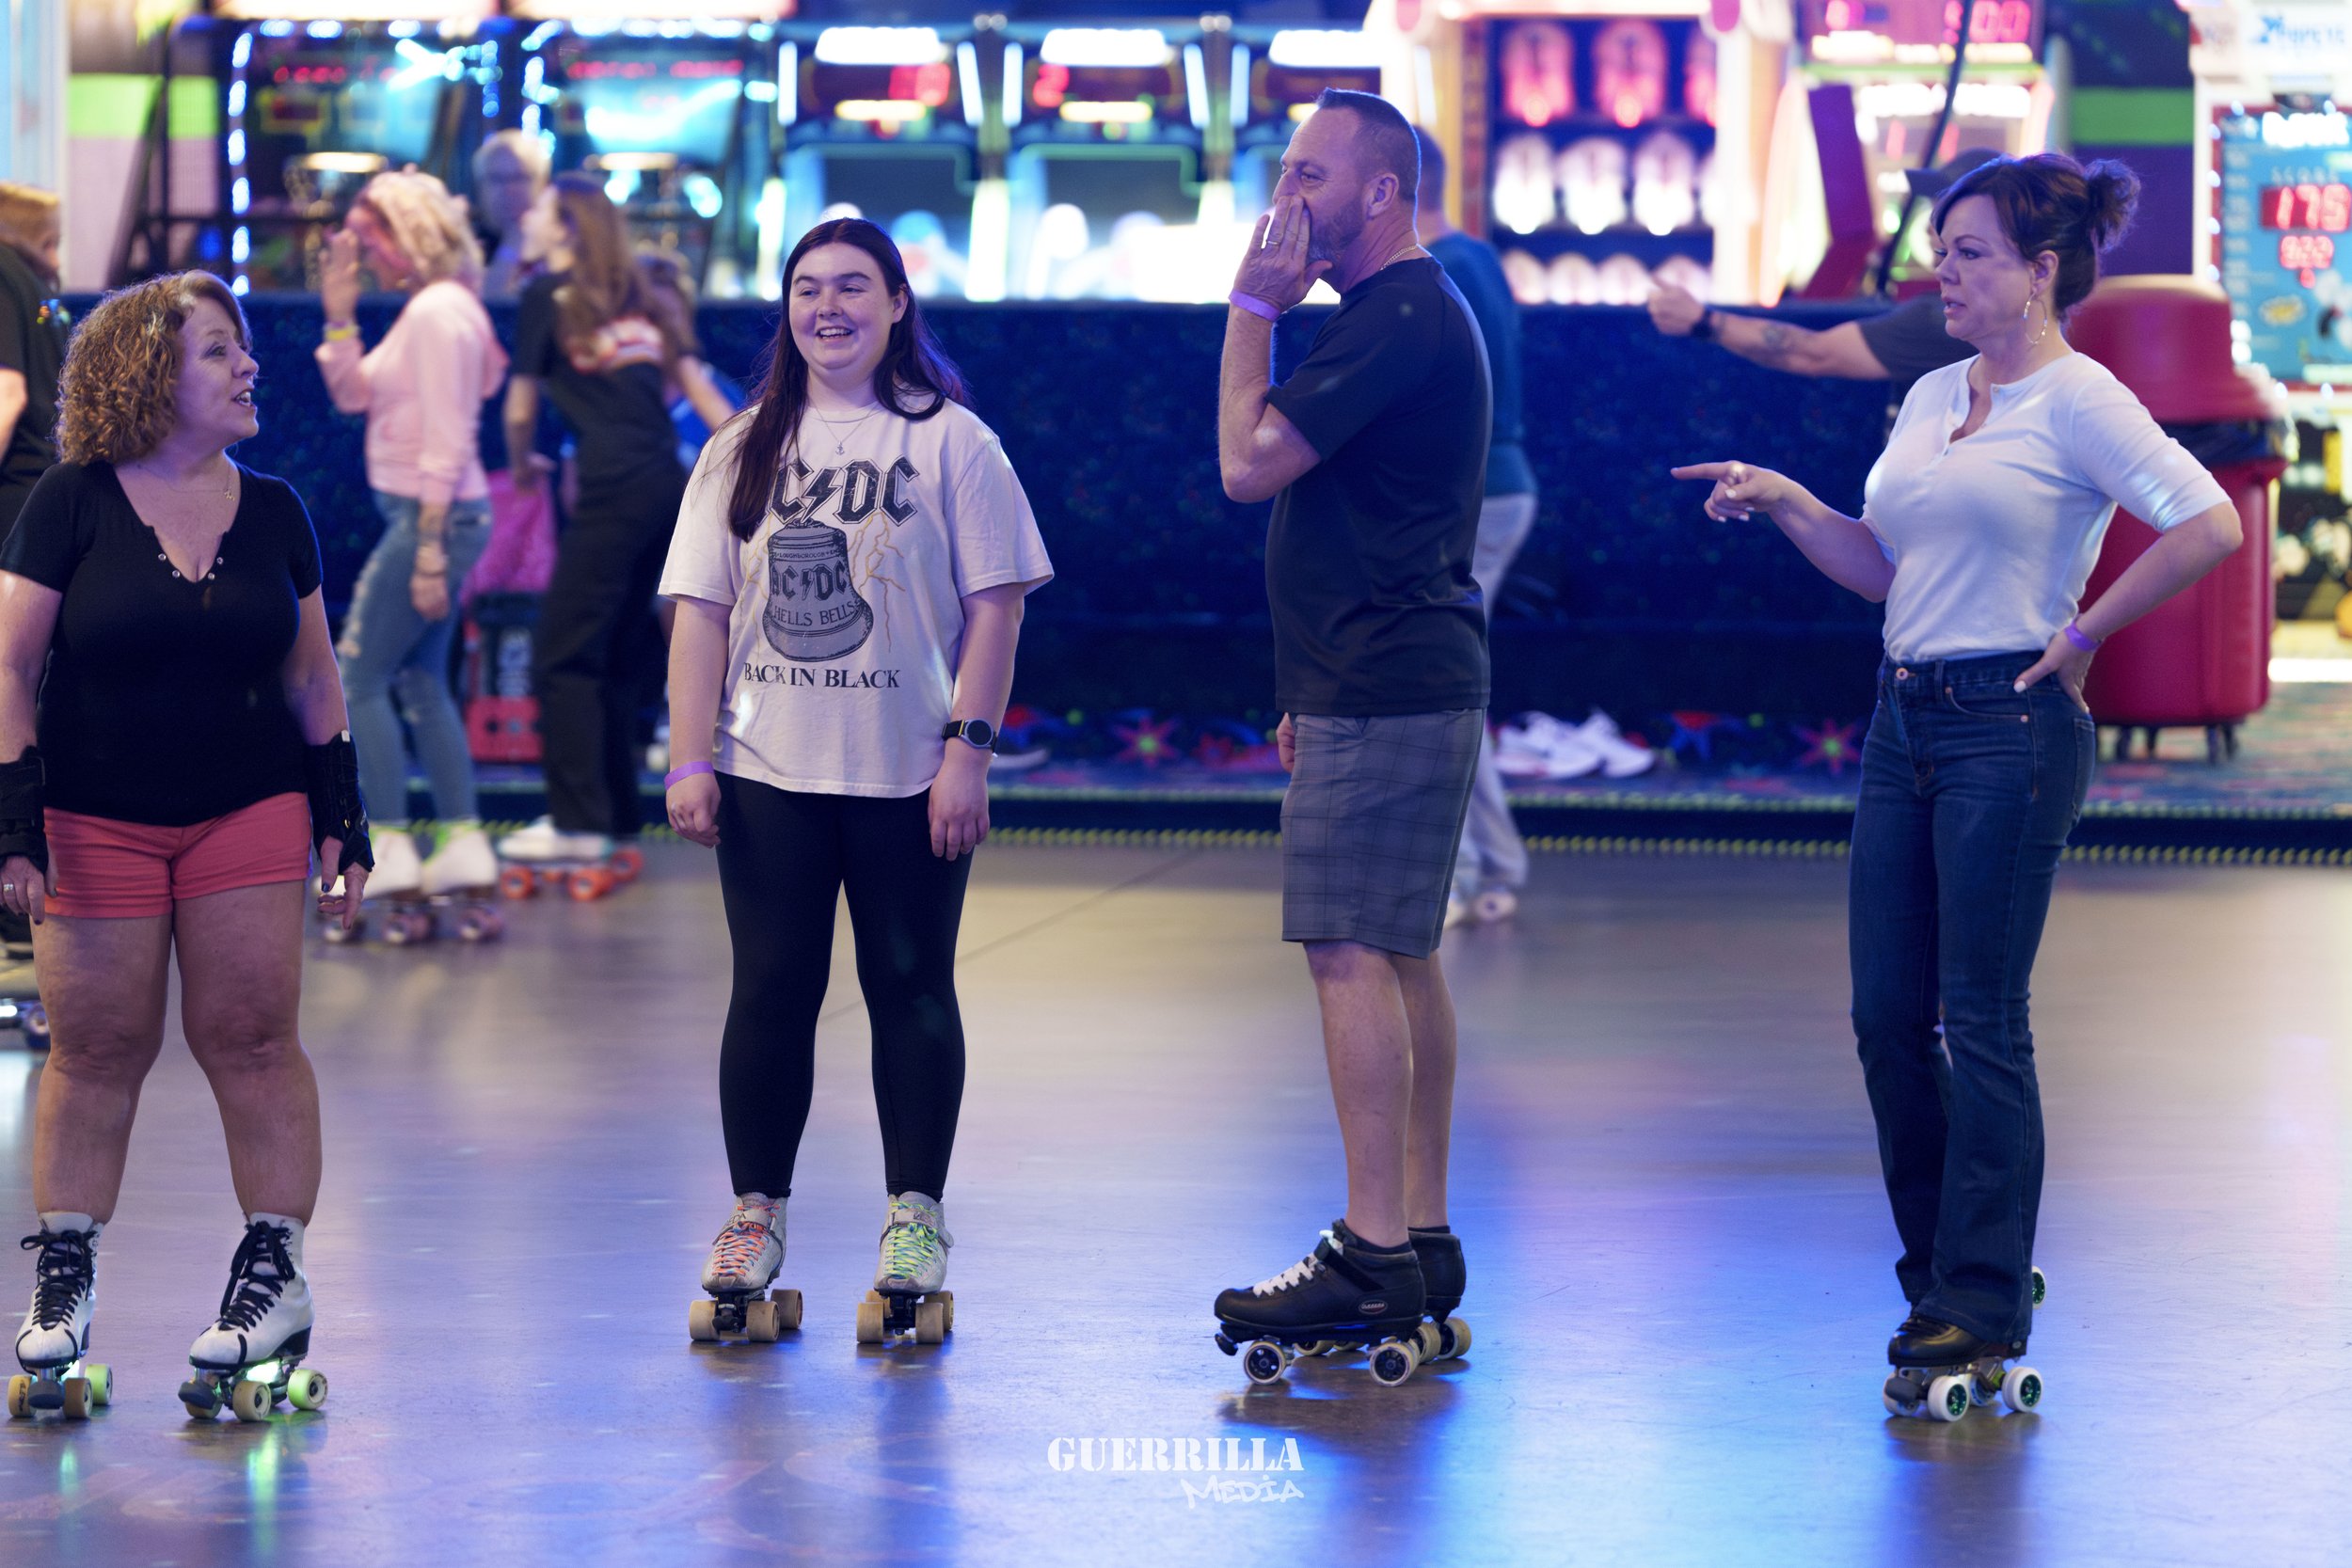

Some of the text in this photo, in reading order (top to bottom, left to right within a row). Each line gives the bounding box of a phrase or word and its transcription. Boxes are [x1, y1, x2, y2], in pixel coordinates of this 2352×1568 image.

[2277, 184, 2351, 231] 175
[758, 455, 919, 527] C/DC
[771, 561, 848, 601] AC/DC
[773, 600, 857, 626] HELLS BELLS
[744, 661, 900, 689] BACK IN BLACK
